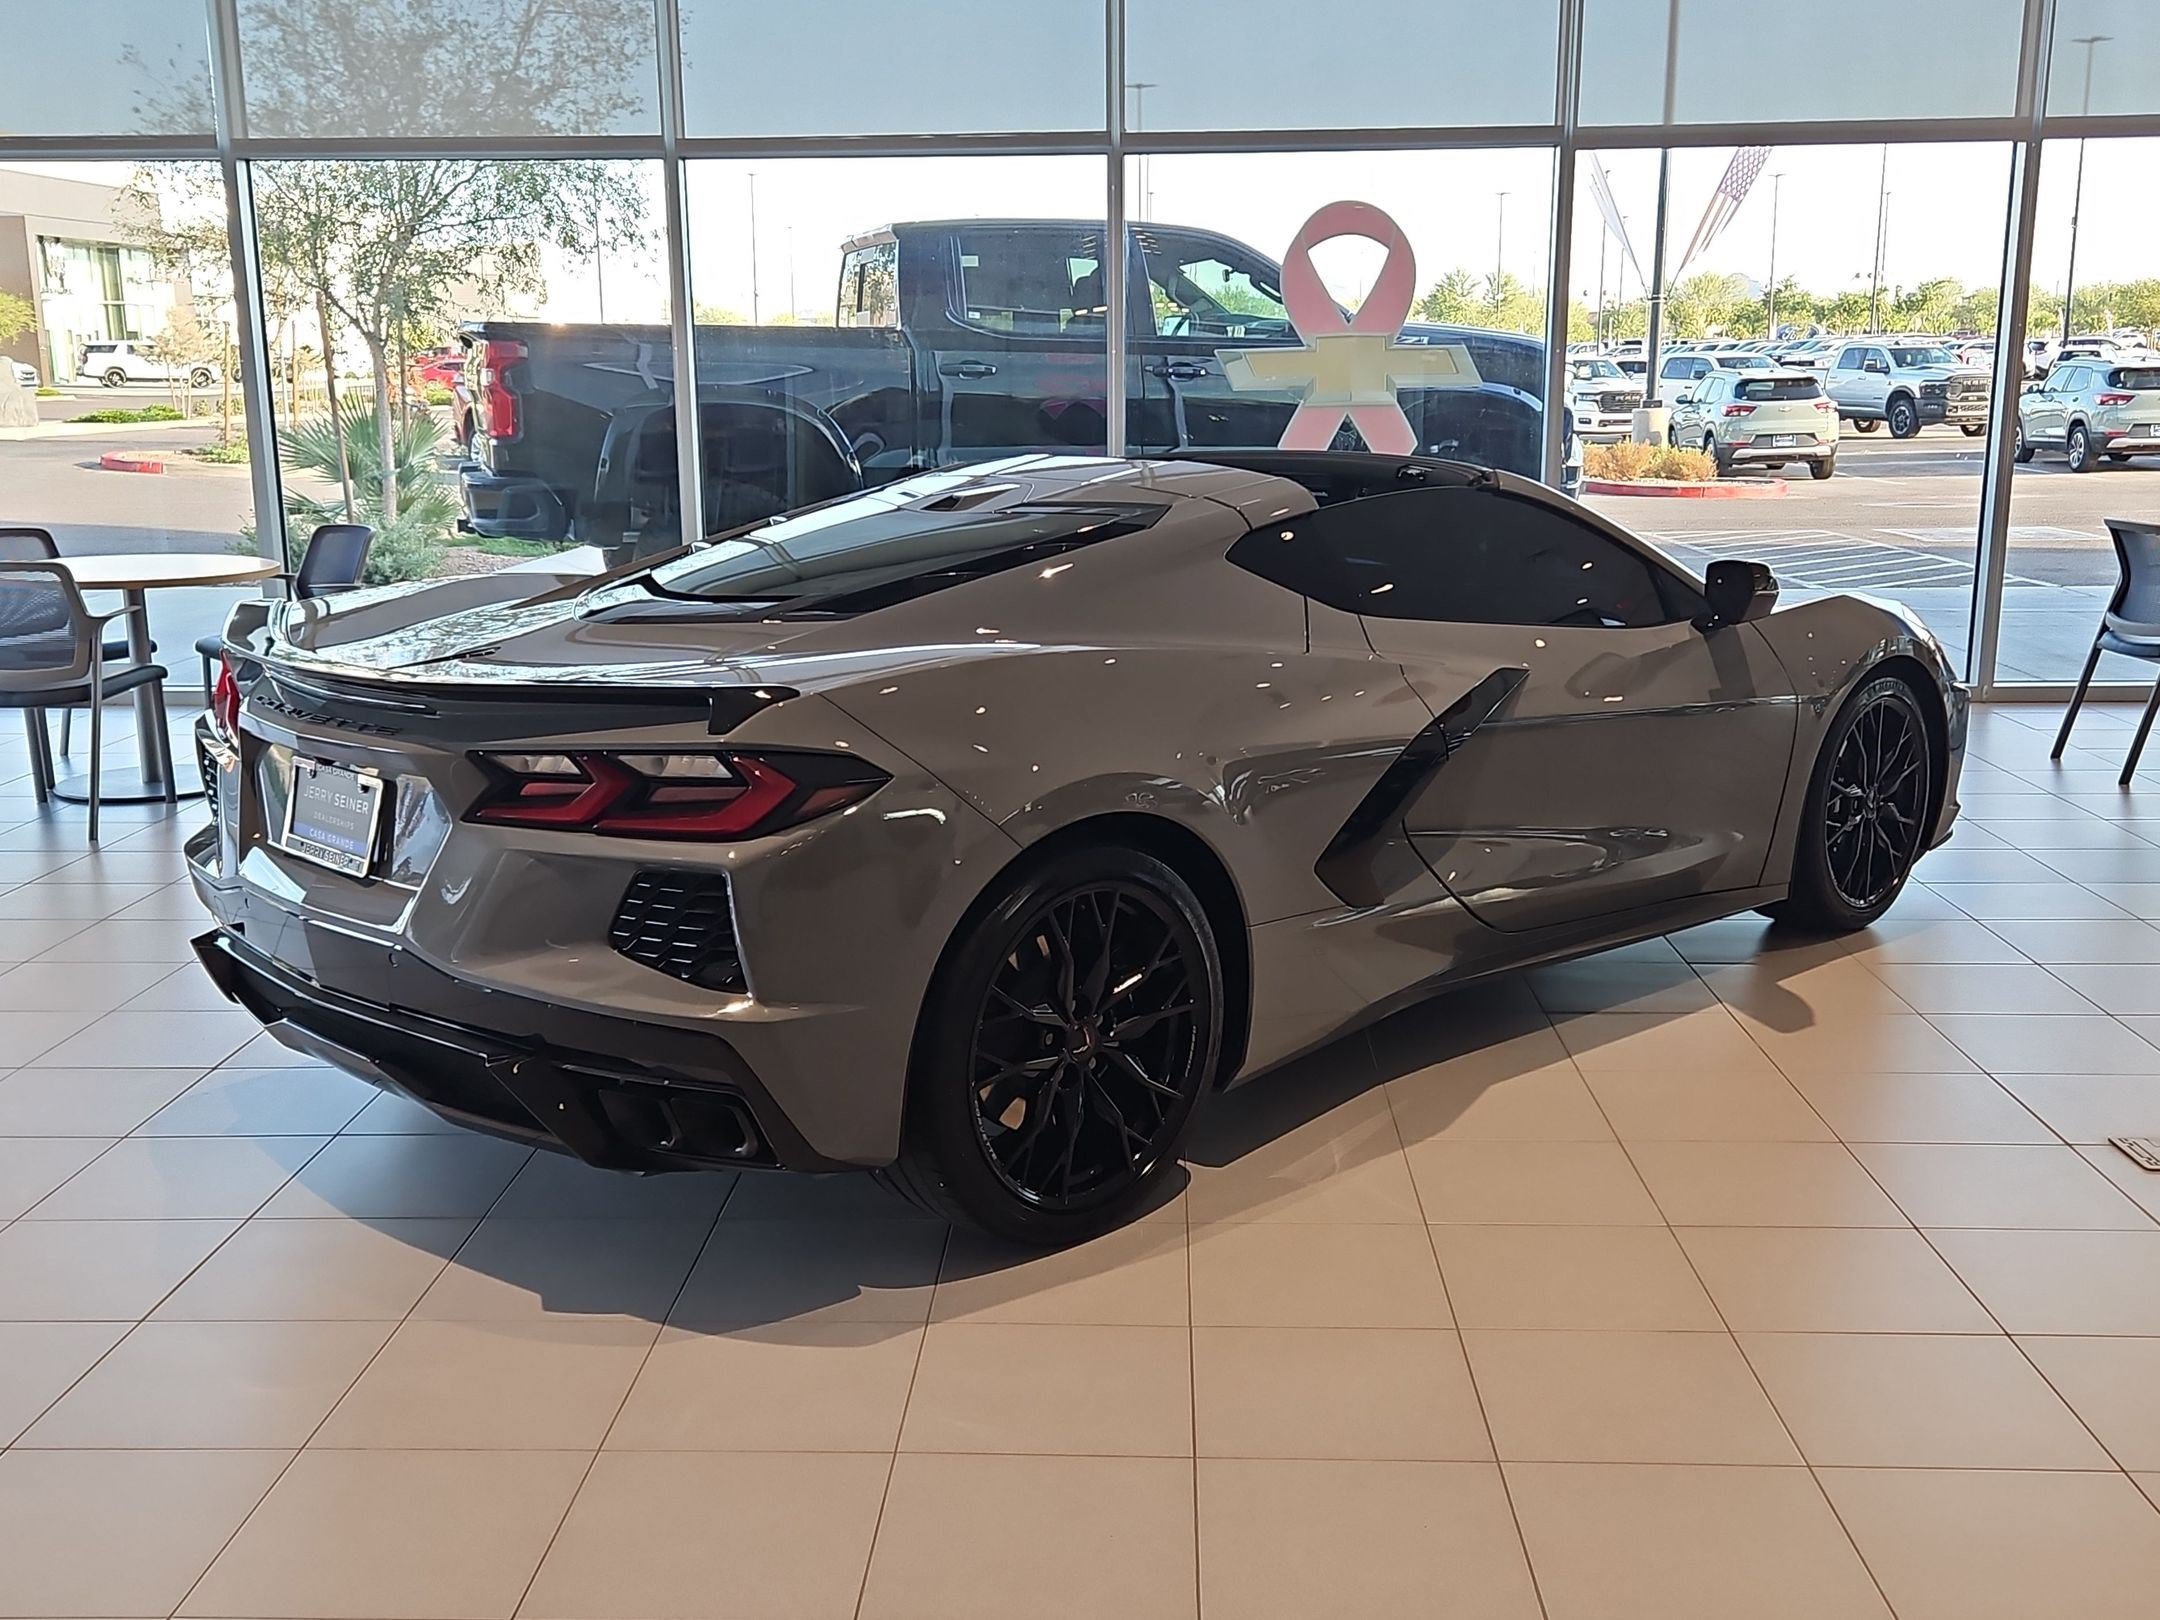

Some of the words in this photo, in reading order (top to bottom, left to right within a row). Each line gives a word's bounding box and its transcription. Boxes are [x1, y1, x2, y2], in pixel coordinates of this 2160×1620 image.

[254, 695, 402, 736] CORVETTE
[304, 785, 334, 803] JERRY
[334, 793, 369, 814] SEINER
[313, 810, 355, 830] DEALERSHIPS
[309, 828, 326, 840] CASA
[327, 833, 355, 850] GRANDE
[302, 843, 324, 860] JERRY
[323, 850, 350, 866] SEINER
